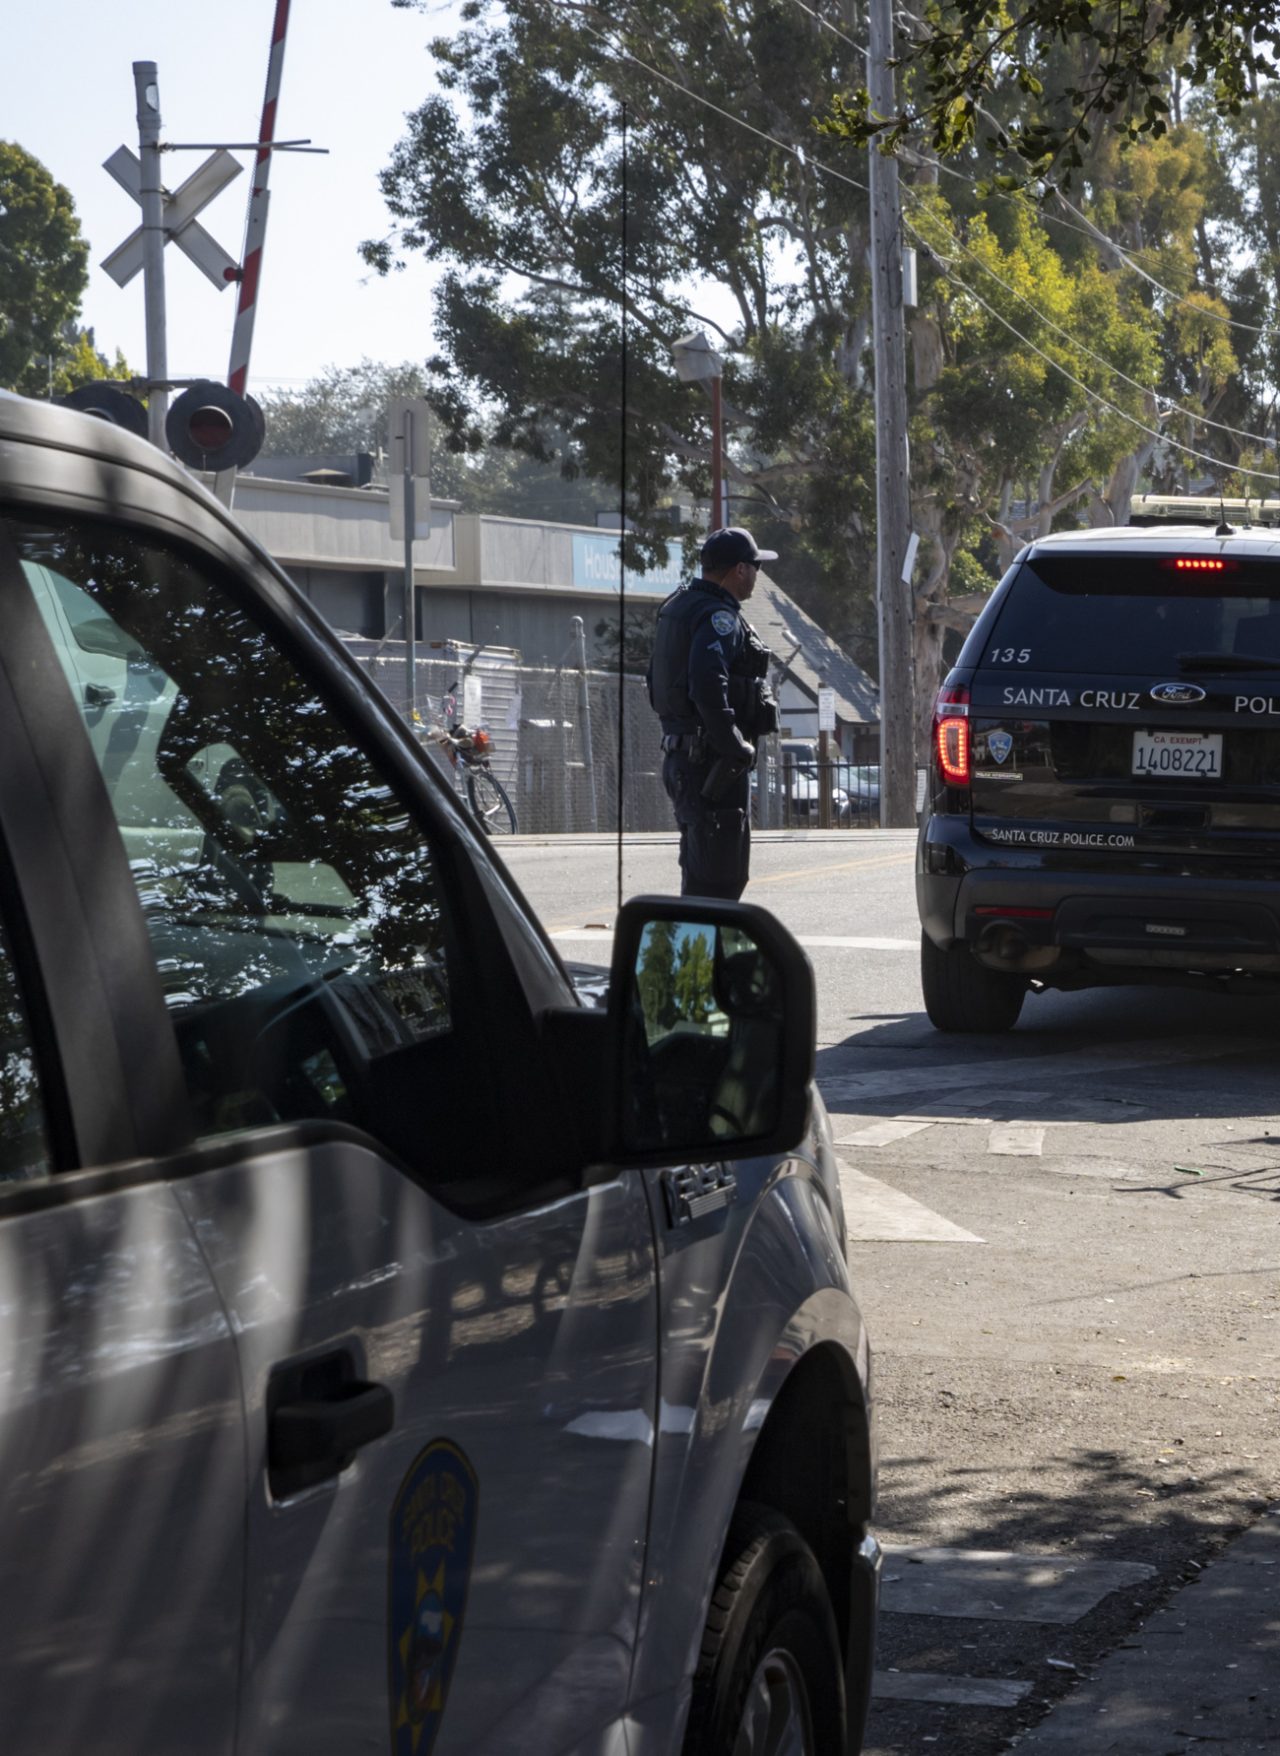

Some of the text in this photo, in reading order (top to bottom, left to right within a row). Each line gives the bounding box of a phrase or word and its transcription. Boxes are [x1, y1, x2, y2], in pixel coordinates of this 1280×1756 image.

[991, 648, 1031, 663] 135
[1003, 687, 1140, 710] SANTA CRUZ
[1161, 685, 1192, 699] Ford
[1153, 735, 1202, 745] CA EXEMPT
[1135, 747, 1218, 773] 1408221
[992, 828, 1135, 847] SANTA CRUZ POLICE.COM
